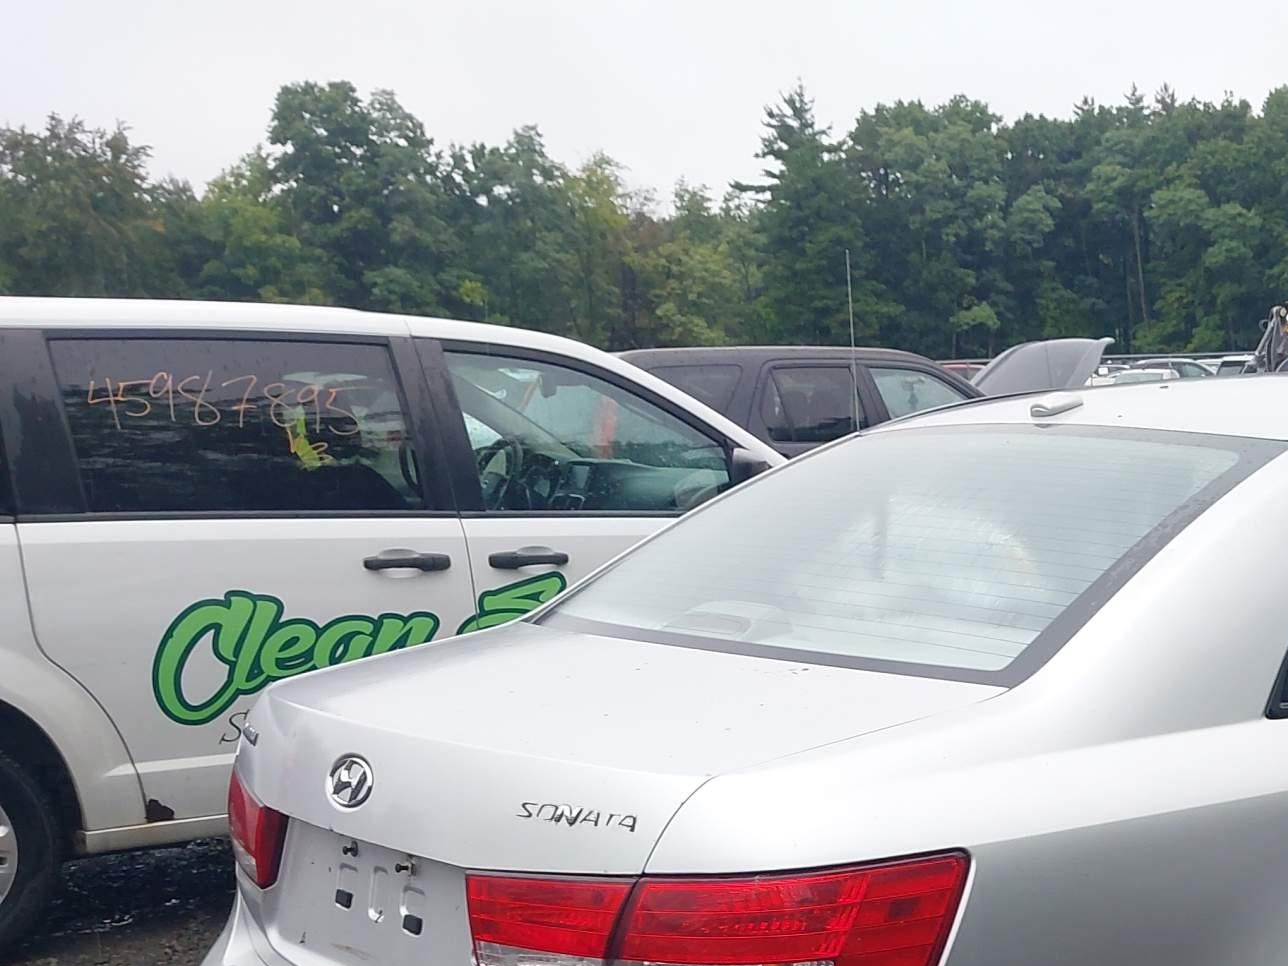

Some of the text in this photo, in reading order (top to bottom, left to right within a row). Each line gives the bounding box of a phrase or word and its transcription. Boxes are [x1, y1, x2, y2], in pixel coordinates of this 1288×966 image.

[88, 370, 370, 435] 45987895
[152, 590, 440, 726] Clean
[515, 802, 637, 832] SONATA
